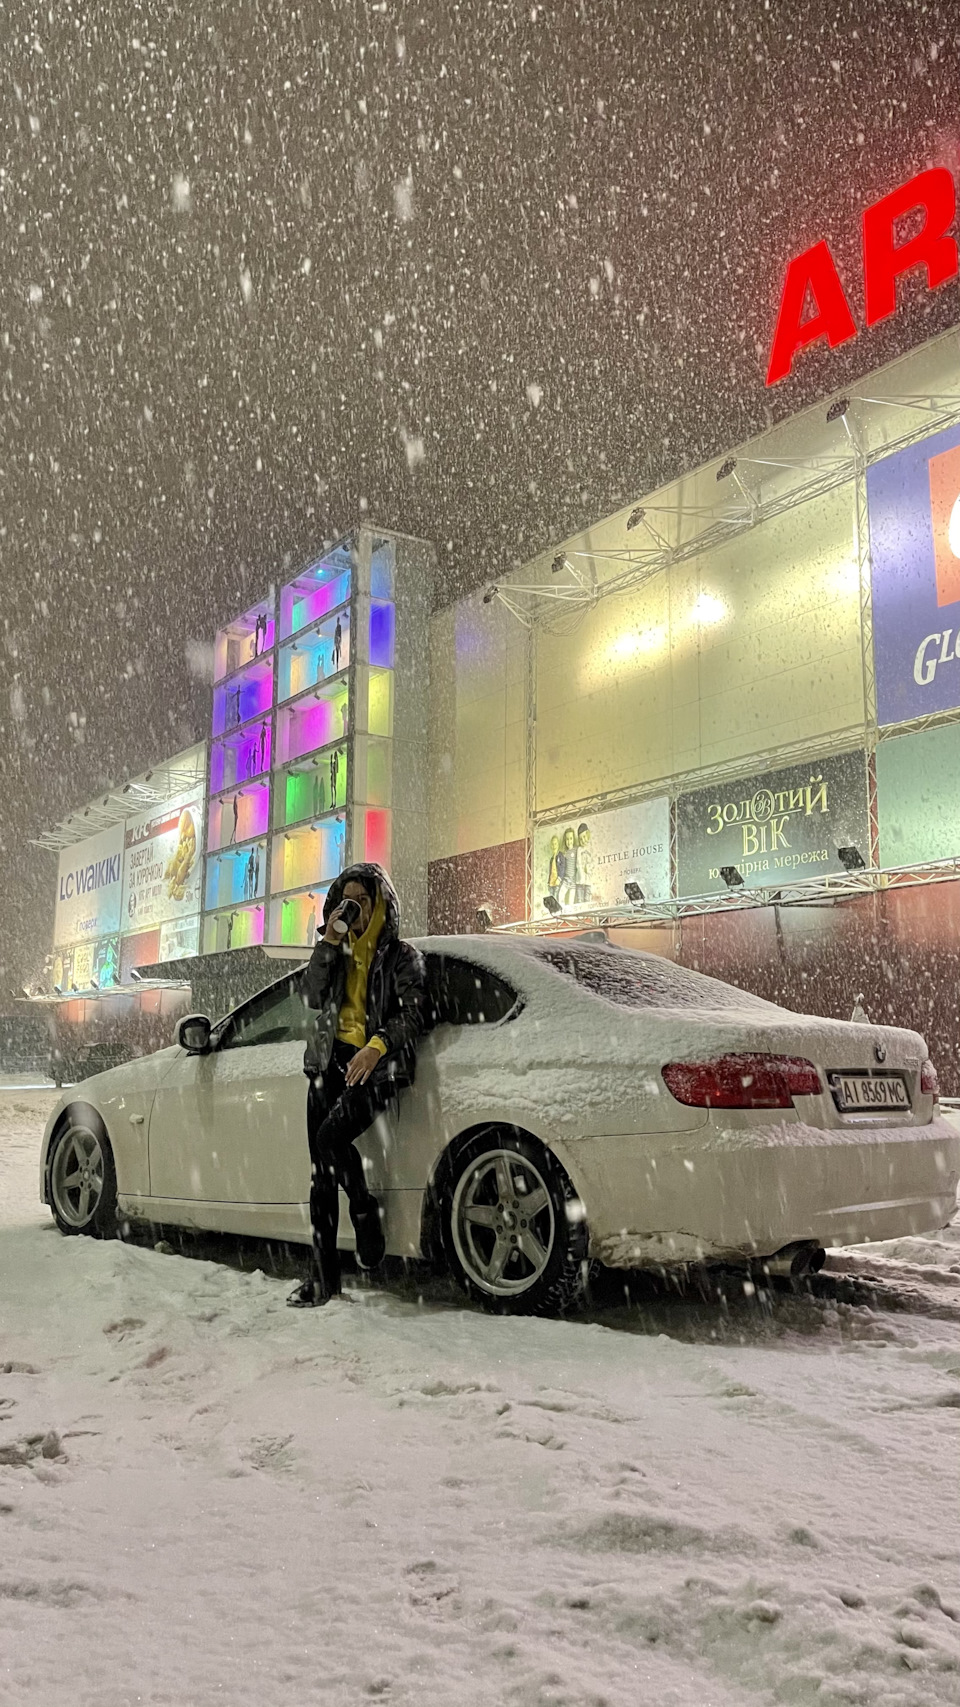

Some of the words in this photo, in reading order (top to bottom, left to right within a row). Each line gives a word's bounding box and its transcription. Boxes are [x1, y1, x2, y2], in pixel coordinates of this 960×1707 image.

[766, 167, 958, 387] AR
[131, 822, 149, 843] KFC
[742, 815, 792, 857] ВІК
[597, 850, 630, 865] LITTLE
[632, 843, 664, 858] HOUSE
[774, 849, 829, 869] мережа
[60, 872, 74, 901] LC
[844, 1081, 860, 1104] AI
[862, 1080, 887, 1103] 8569
[888, 1081, 905, 1103] MC
